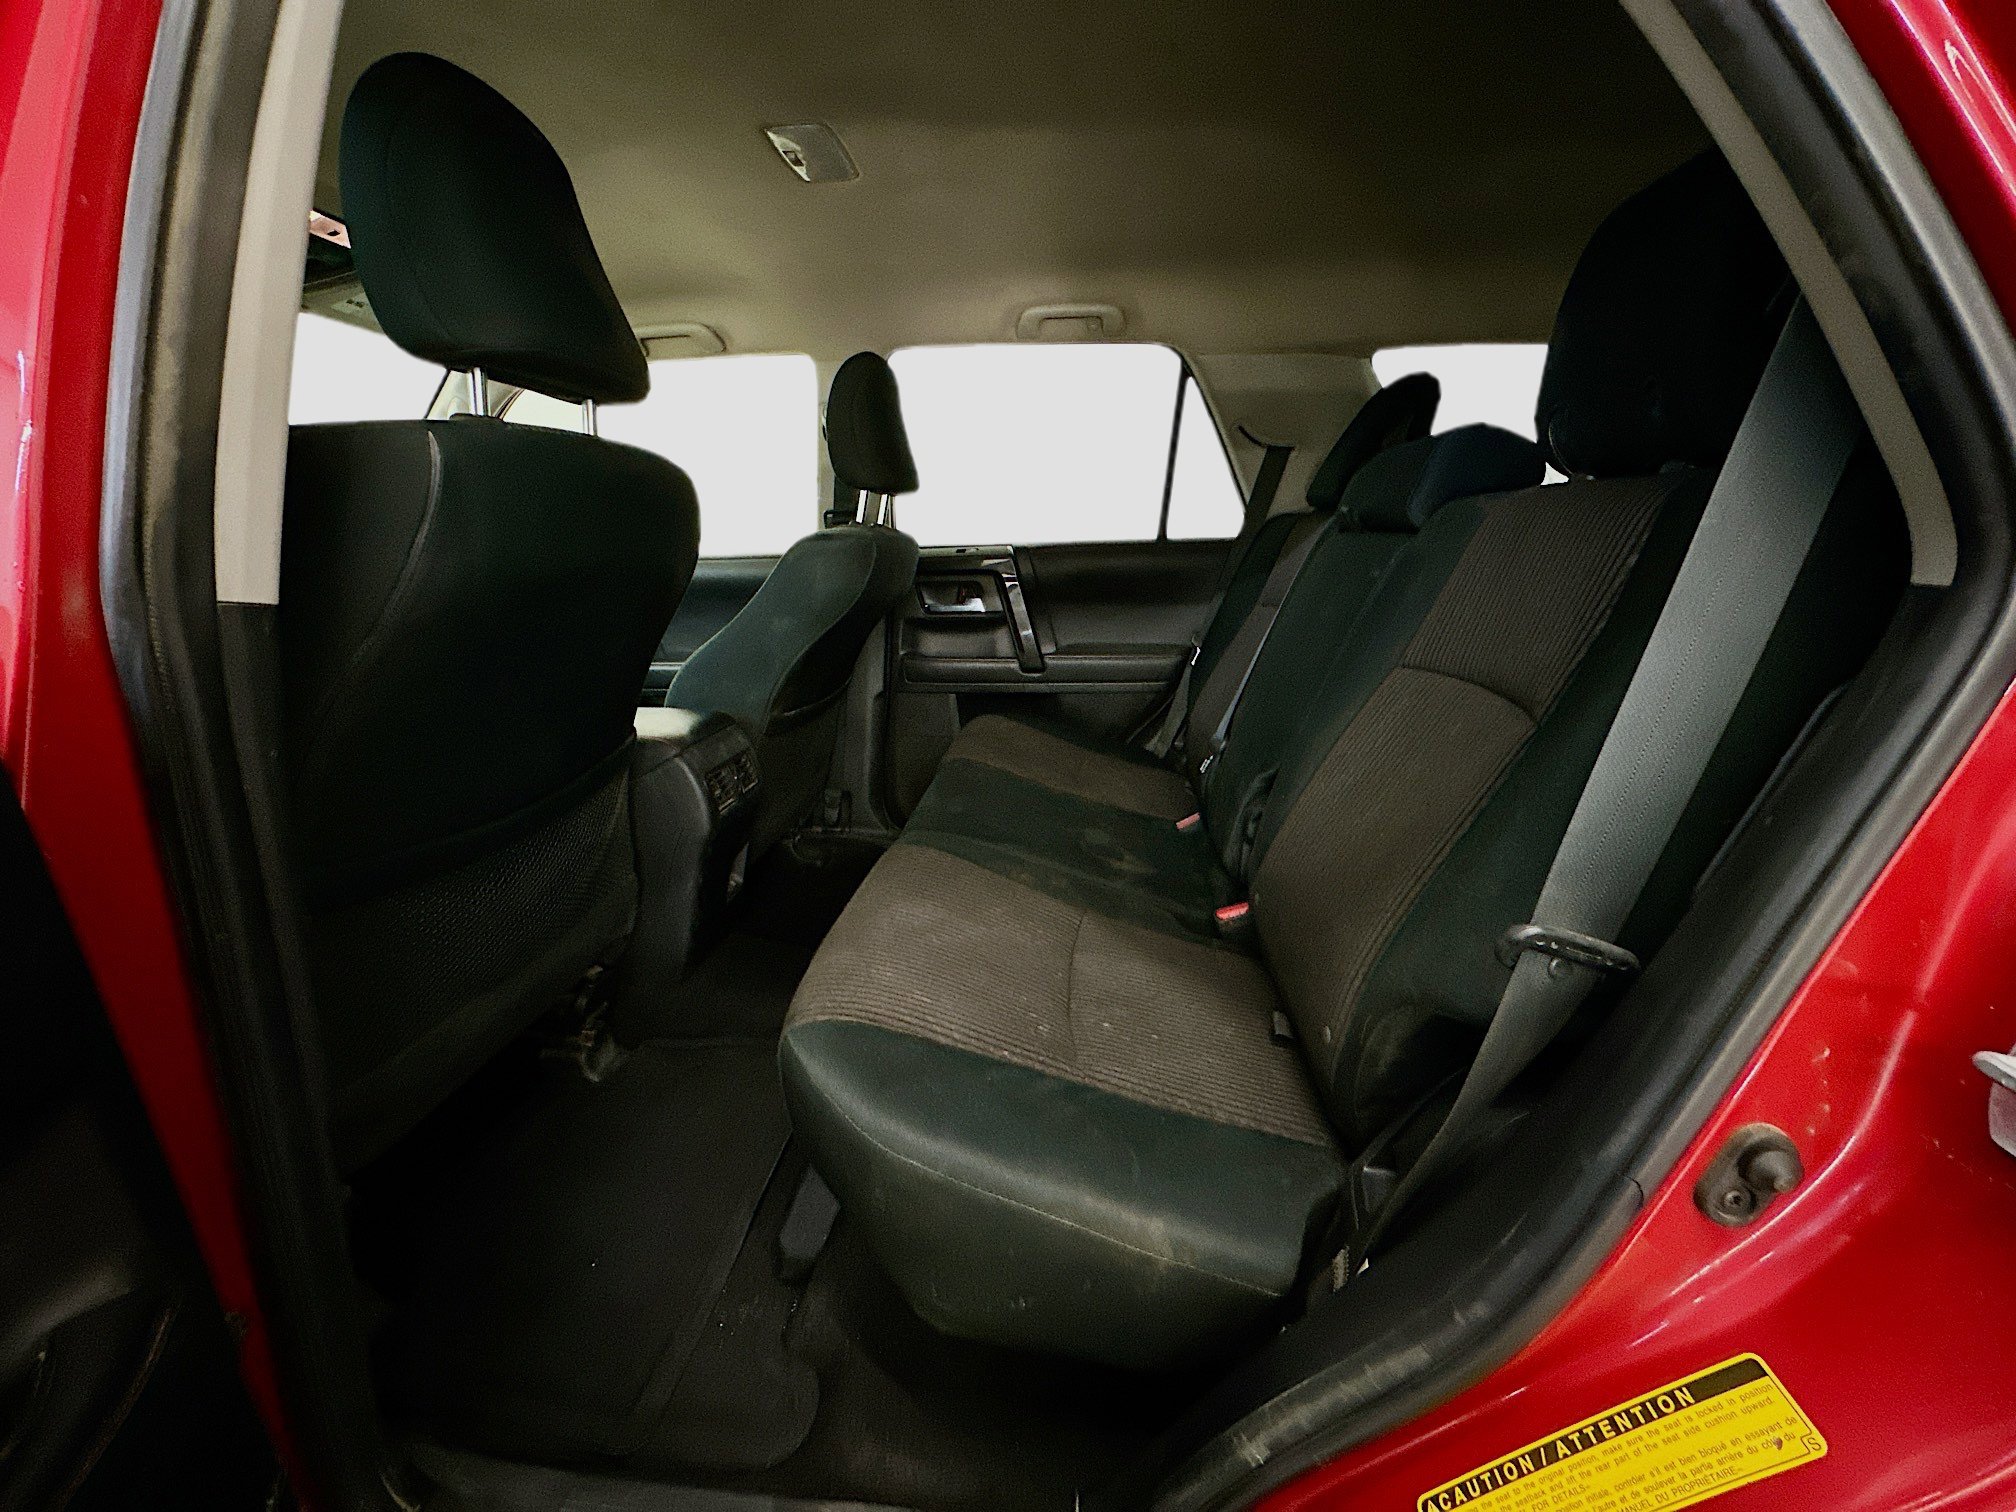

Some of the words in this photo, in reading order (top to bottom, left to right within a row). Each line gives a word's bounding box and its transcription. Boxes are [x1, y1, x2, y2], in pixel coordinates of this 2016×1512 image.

[1438, 1454, 1535, 1511] CAUTION
[1555, 1386, 1695, 1458] ATTENTION
[1480, 1499, 1493, 1509] the
[1494, 1491, 1510, 1503] seat
[1512, 1486, 1521, 1495] to
[1522, 1480, 1536, 1491] the
[1537, 1466, 1566, 1486] original
[1601, 1442, 1622, 1457] make
[1625, 1434, 1644, 1446] sure
[1645, 1427, 1660, 1438] the
[1663, 1418, 1681, 1431] seat
[1684, 1413, 1693, 1422] is
[1695, 1401, 1723, 1418] locked
[1726, 1396, 1736, 1405] in
[1739, 1383, 1773, 1402] position
[1514, 1487, 1546, 1507] seatback
[1548, 1480, 1563, 1491] and
[1578, 1468, 1592, 1479] the
[1594, 1460, 1610, 1472] rear
[1613, 1452, 1630, 1466] part
[1632, 1447, 1642, 1456] of
[1644, 1441, 1658, 1451] the
[1661, 1432, 1680, 1445] seat
[1683, 1424, 1701, 1436] side
[1704, 1410, 1738, 1429] cushion
[1741, 1397, 1774, 1415] upward.
[1619, 1494, 1627, 1503] et
[1630, 1489, 1640, 1499] de
[1642, 1475, 1676, 1494] soulever
[1678, 1470, 1687, 1480] la
[1689, 1460, 1714, 1478] partie
[1746, 1443, 1758, 1455] du
[1783, 1433, 1795, 1441] du
[1663, 1460, 1676, 1471] est
[1678, 1452, 1697, 1465] bien
[1698, 1440, 1728, 1459] bloqué
[1729, 1436, 1742, 1446] en
[1745, 1421, 1782, 1442] essayant
[1784, 1416, 1797, 1425] de
[1807, 1437, 1821, 1451] S
[1531, 1499, 1549, 1512] FOR
[1654, 1491, 1669, 1503] DU
